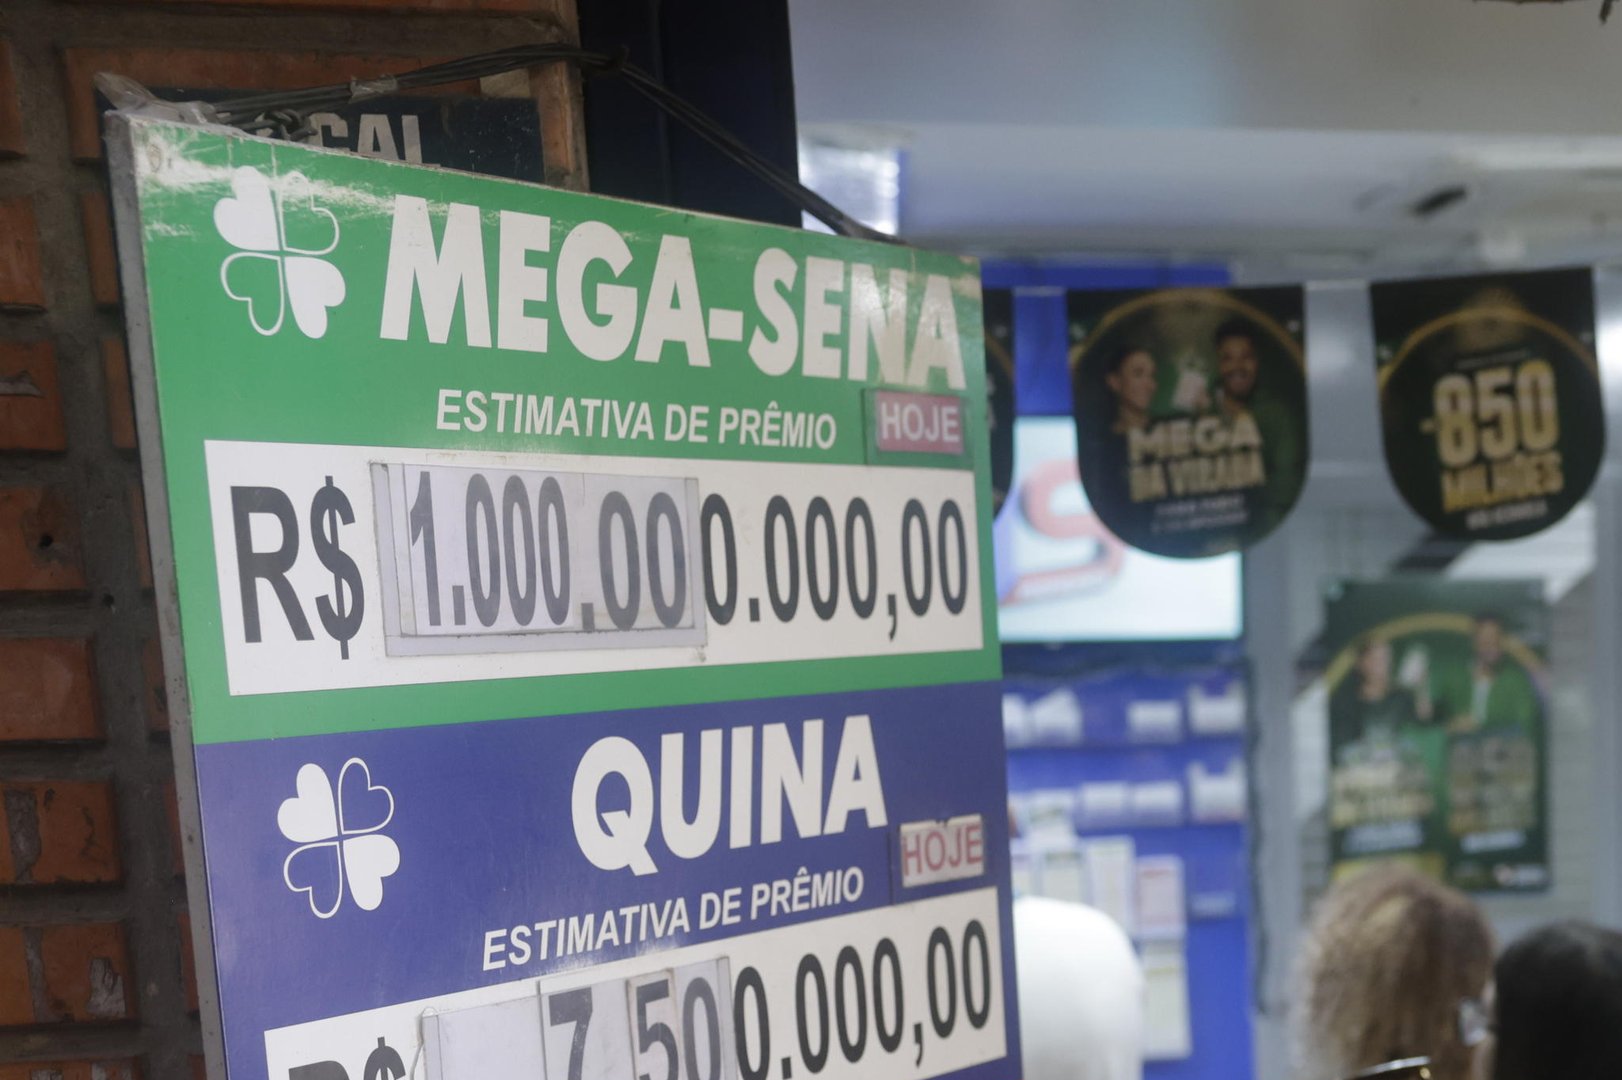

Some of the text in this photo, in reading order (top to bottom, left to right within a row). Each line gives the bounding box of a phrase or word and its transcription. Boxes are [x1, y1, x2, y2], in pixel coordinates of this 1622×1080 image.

[380, 194, 967, 391] MEGA-SENA
[436, 388, 837, 451] ESTIMATIVA DE PRÊMIO
[880, 402, 960, 447] HOJE
[1128, 412, 1263, 465] MEGA
[230, 475, 366, 661] R$
[411, 469, 968, 642] 1.000.000.000,00
[571, 714, 888, 876] QUINA
[902, 822, 983, 880] HOJE
[482, 866, 864, 972] ESTIMATIVA DE PRÊMIO
